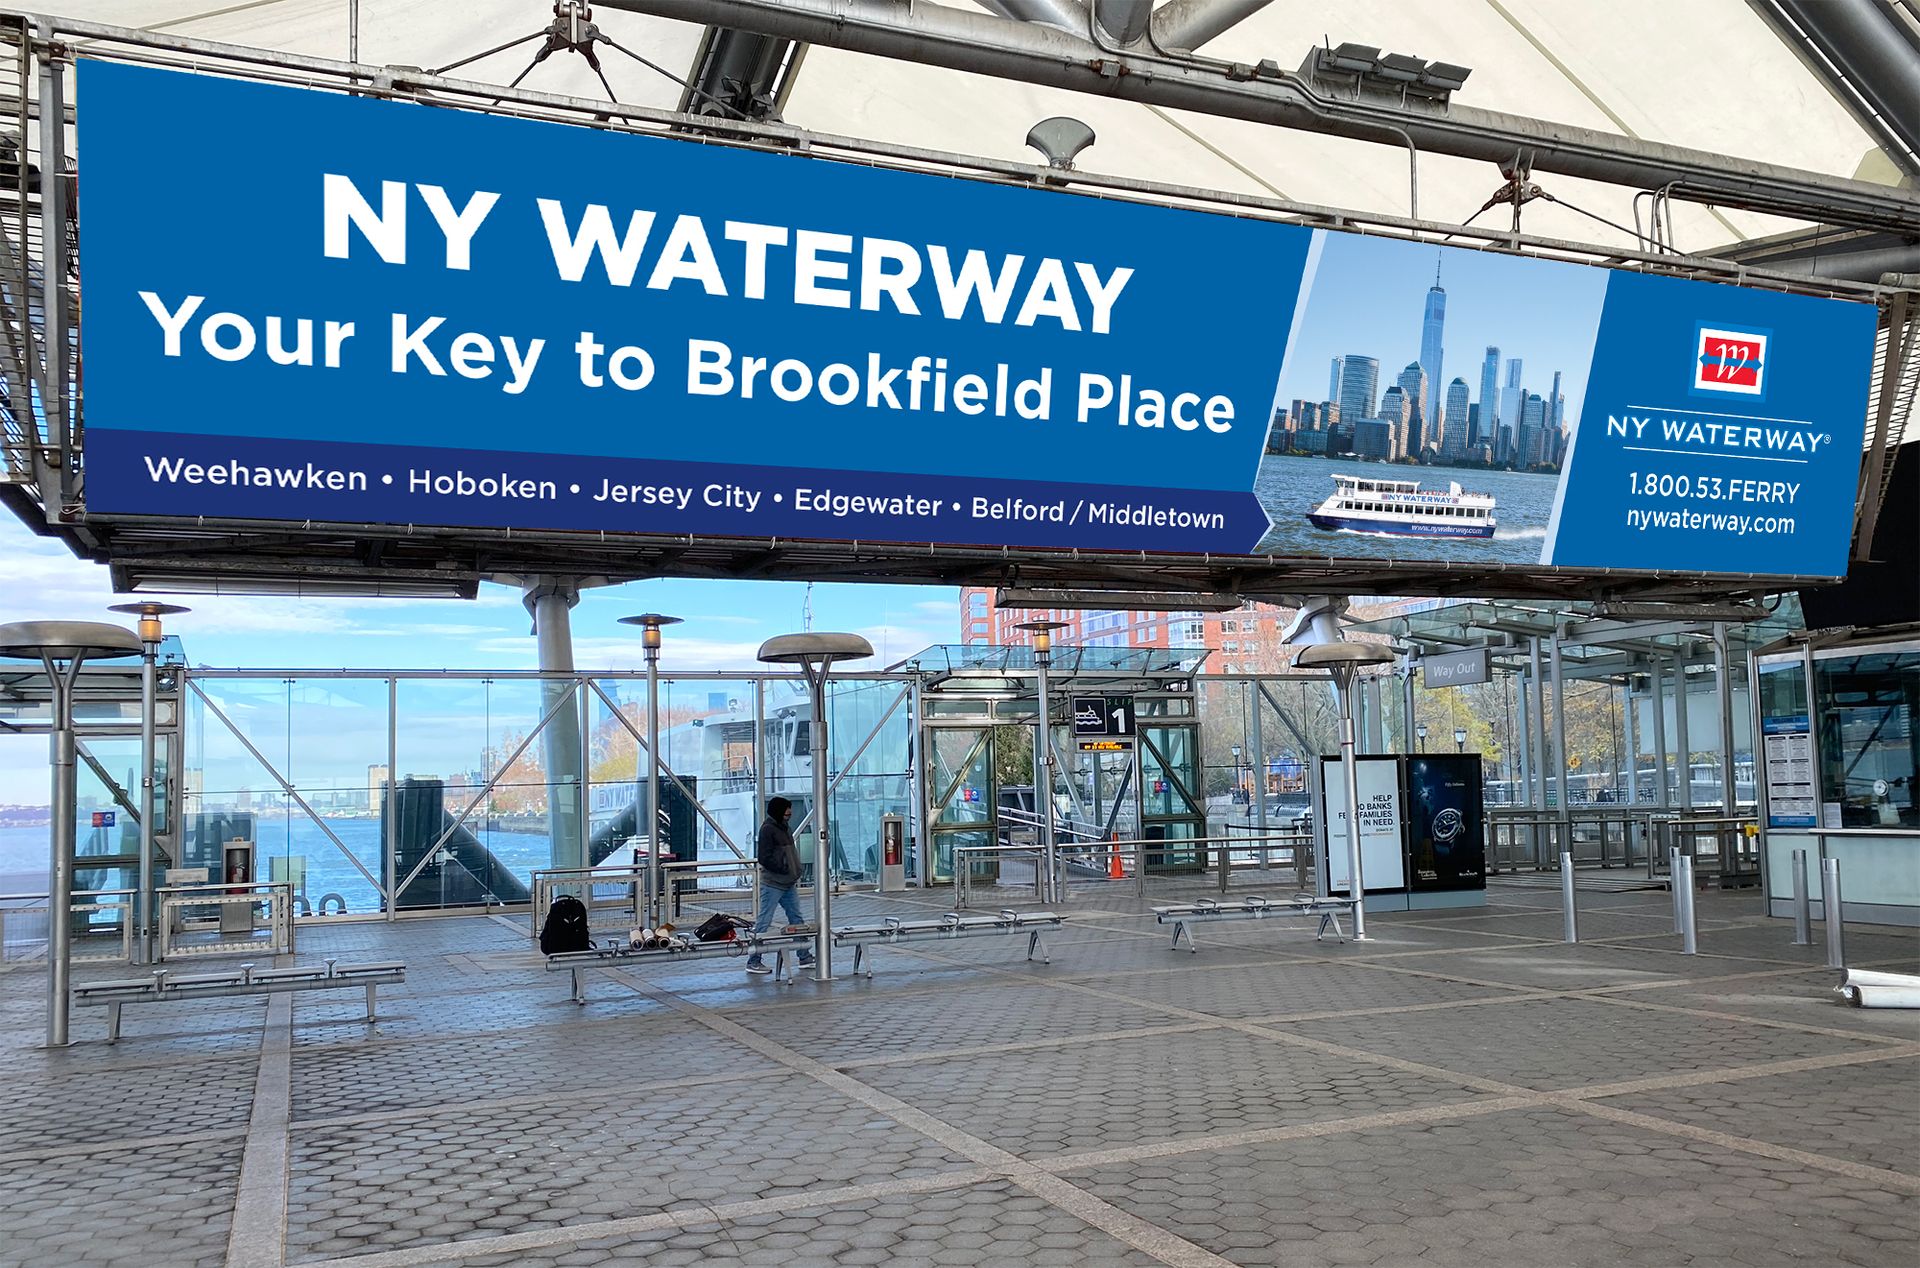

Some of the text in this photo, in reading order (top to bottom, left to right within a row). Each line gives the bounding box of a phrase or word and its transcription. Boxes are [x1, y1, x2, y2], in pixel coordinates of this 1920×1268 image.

[324, 174, 1135, 335] NY WATERWAY
[138, 292, 1235, 434] Your Key to Brookfield Place
[1606, 415, 1651, 439] NY
[143, 457, 368, 491] Weehawken
[408, 469, 556, 500] Hoboken
[593, 479, 693, 511] Jersey
[704, 484, 762, 513] City
[795, 488, 943, 518] Edgewater
[972, 497, 1065, 523] Belford
[1089, 503, 1224, 530] Middletown
[1403, 495, 1452, 504] WATERWAY
[1629, 472, 1801, 503] 1.800.53.FERRY
[1627, 509, 1795, 536] nywaterway.com
[1433, 662, 1476, 679] Way Out
[1107, 698, 1133, 706] SLIP
[1111, 708, 1126, 733] 1
[1366, 802, 1393, 811] BANKS
[1372, 794, 1393, 802] HELP
[1359, 810, 1393, 818] FAMILIES
